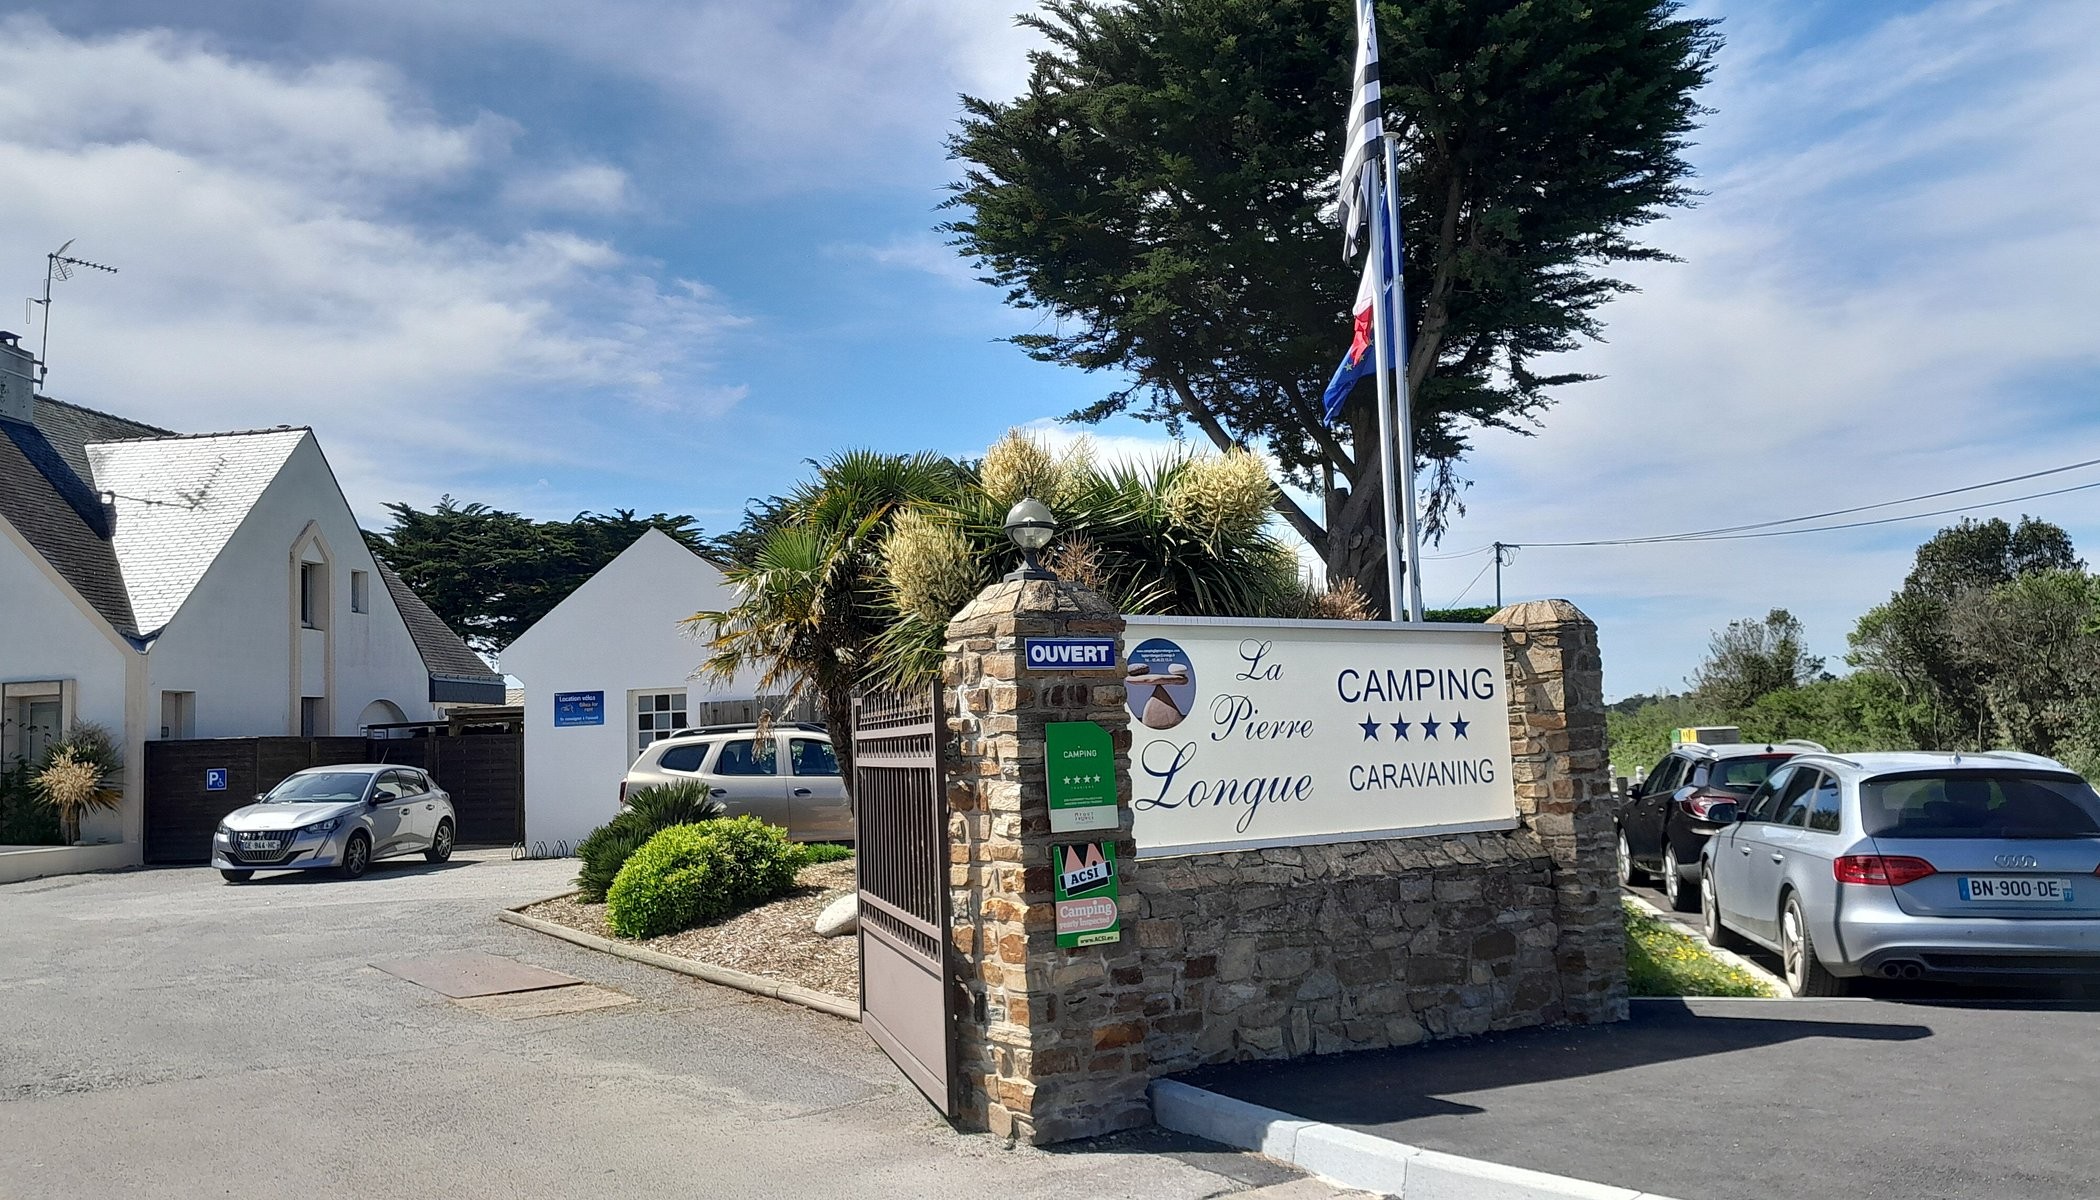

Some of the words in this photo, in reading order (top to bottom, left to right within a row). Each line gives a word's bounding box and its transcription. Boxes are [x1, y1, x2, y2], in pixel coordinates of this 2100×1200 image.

[1031, 645, 1109, 663] OUVERT
[1236, 638, 1284, 681] La
[1337, 668, 1494, 703] CAMPING
[1210, 694, 1314, 742] Pierre
[1063, 749, 1097, 759] CAMPING
[209, 772, 219, 785] P
[1349, 759, 1495, 791] CARAVANING
[1134, 739, 1315, 834] Longue
[1070, 867, 1100, 885] ACSI
[1971, 880, 2060, 897] BN-900-DE
[1060, 900, 1112, 918] Camping
